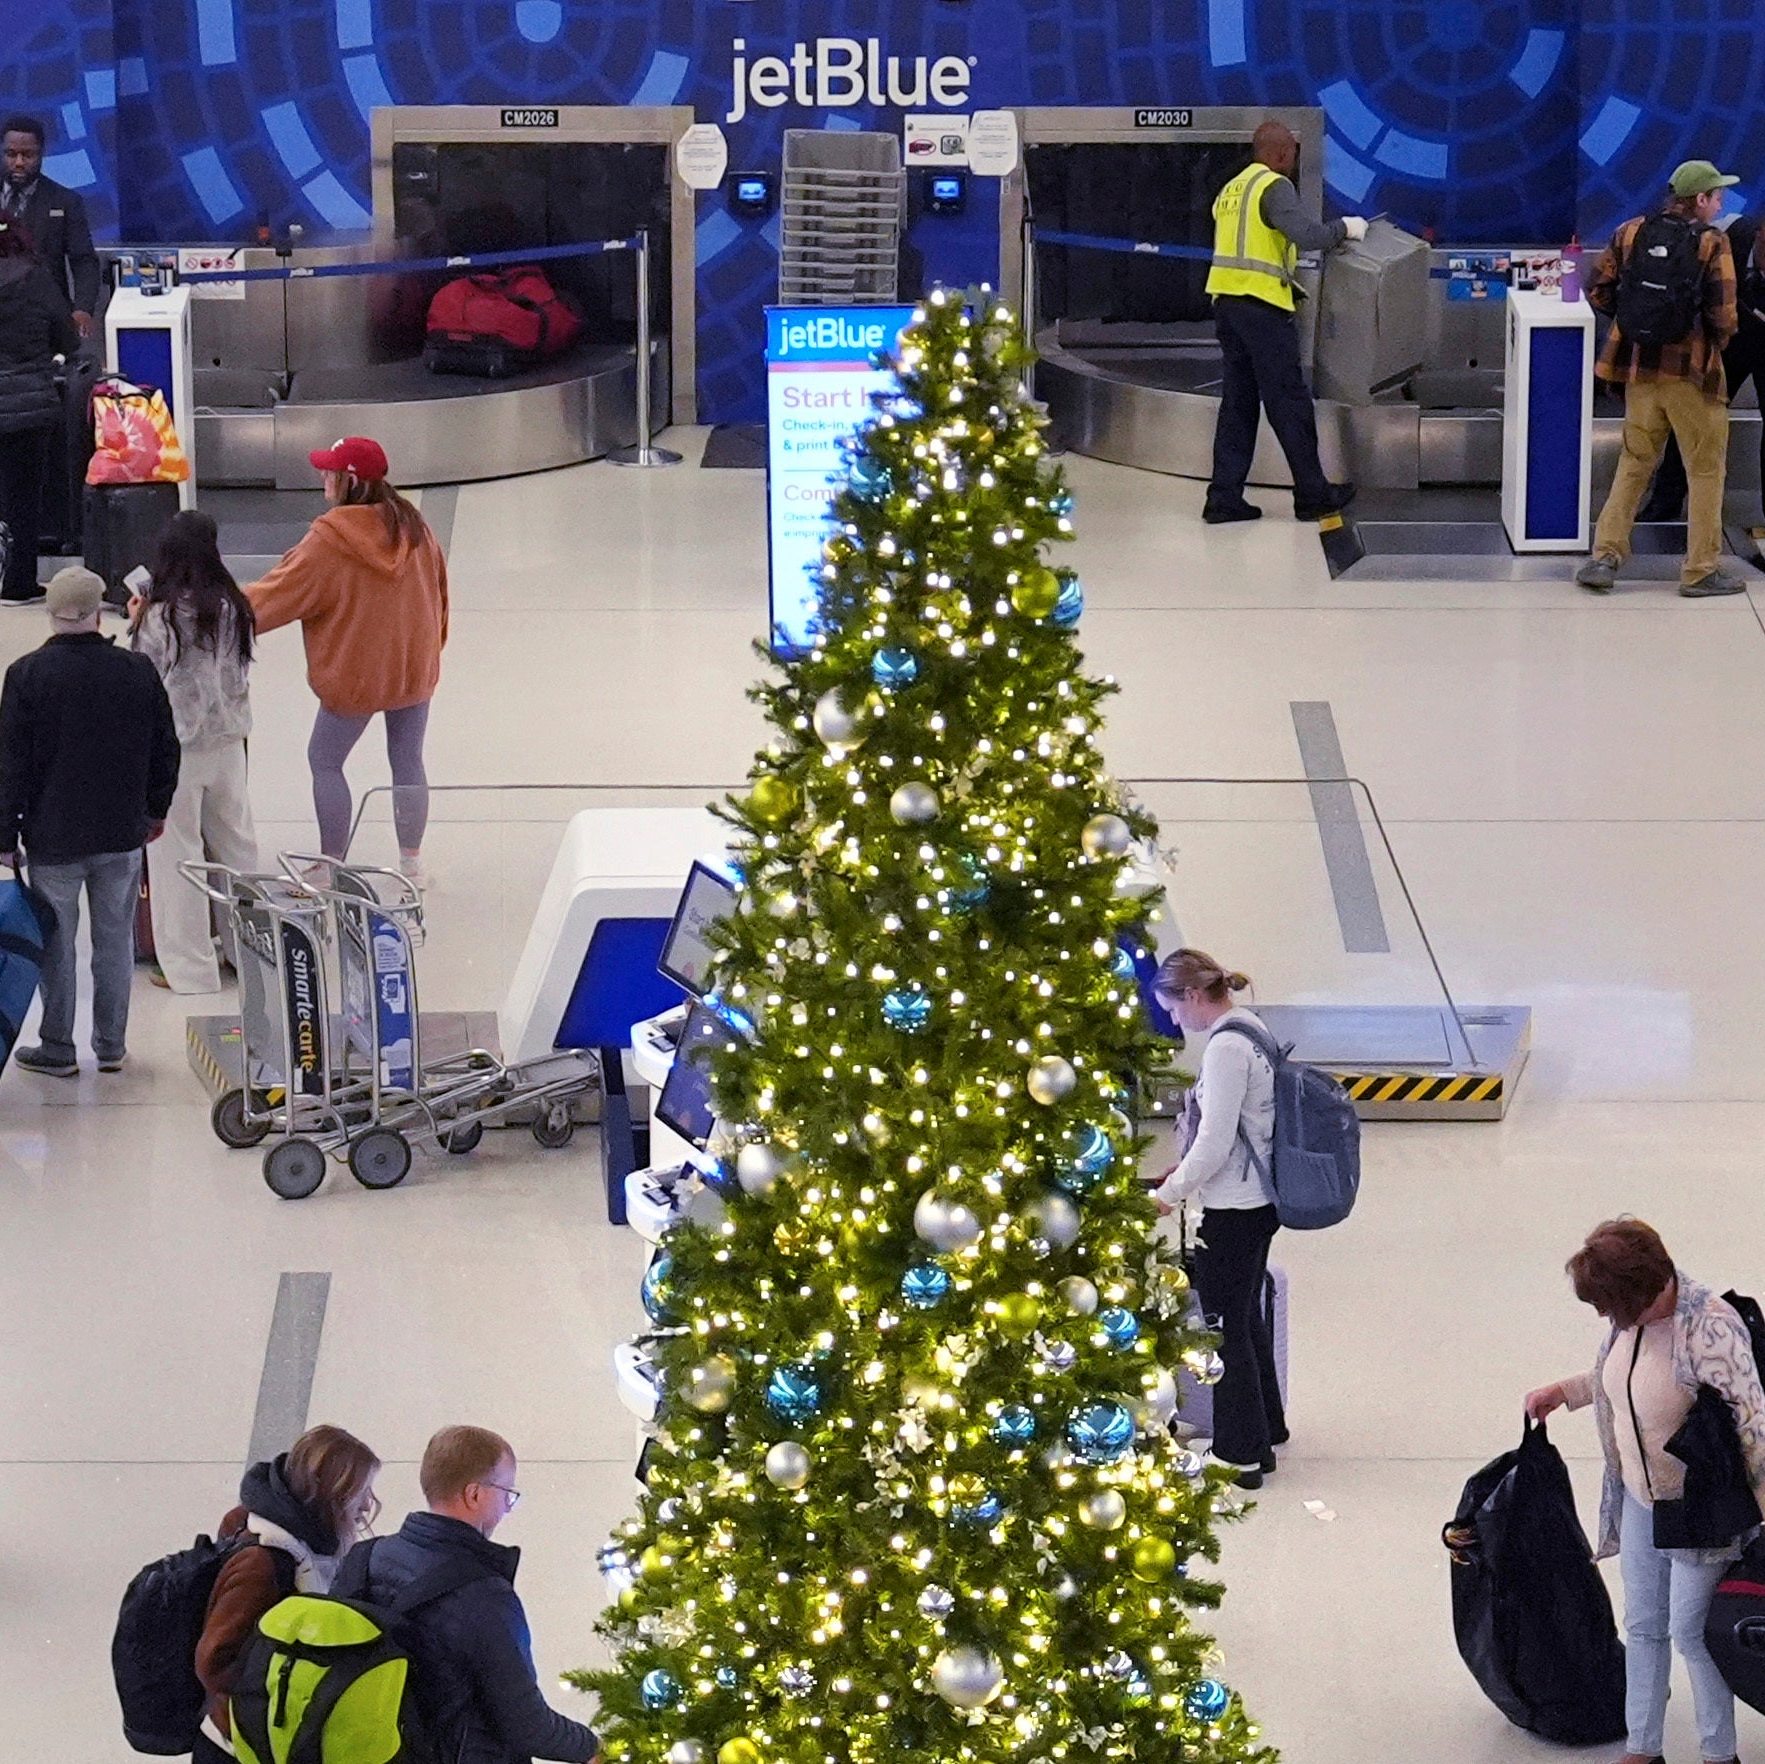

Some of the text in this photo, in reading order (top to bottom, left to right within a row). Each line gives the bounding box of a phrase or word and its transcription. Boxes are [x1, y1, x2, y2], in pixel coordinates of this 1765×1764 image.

[726, 37, 971, 124] jetBlue
[504, 111, 555, 125] CM2026
[1138, 111, 1189, 125] CM2030
[779, 317, 884, 355] jetBlue
[783, 386, 852, 409] Start
